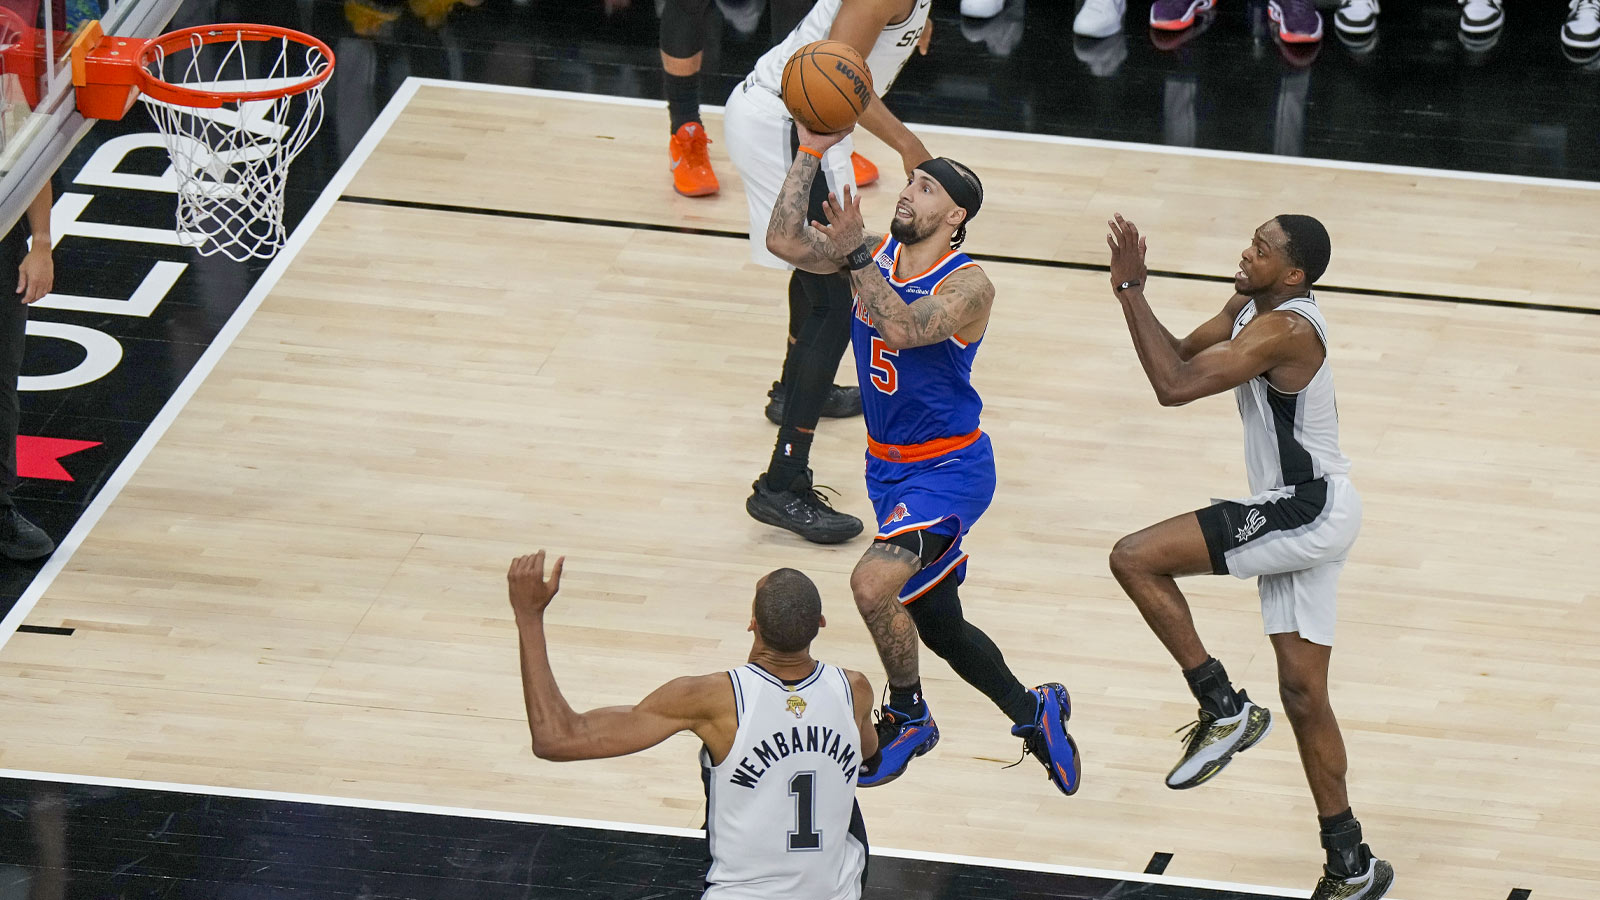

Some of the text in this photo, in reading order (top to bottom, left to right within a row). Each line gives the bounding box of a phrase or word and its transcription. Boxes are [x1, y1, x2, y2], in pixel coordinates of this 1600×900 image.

[870, 335, 900, 396] 5
[730, 726, 857, 789] WEMBANYAMA
[787, 770, 823, 852] 1
